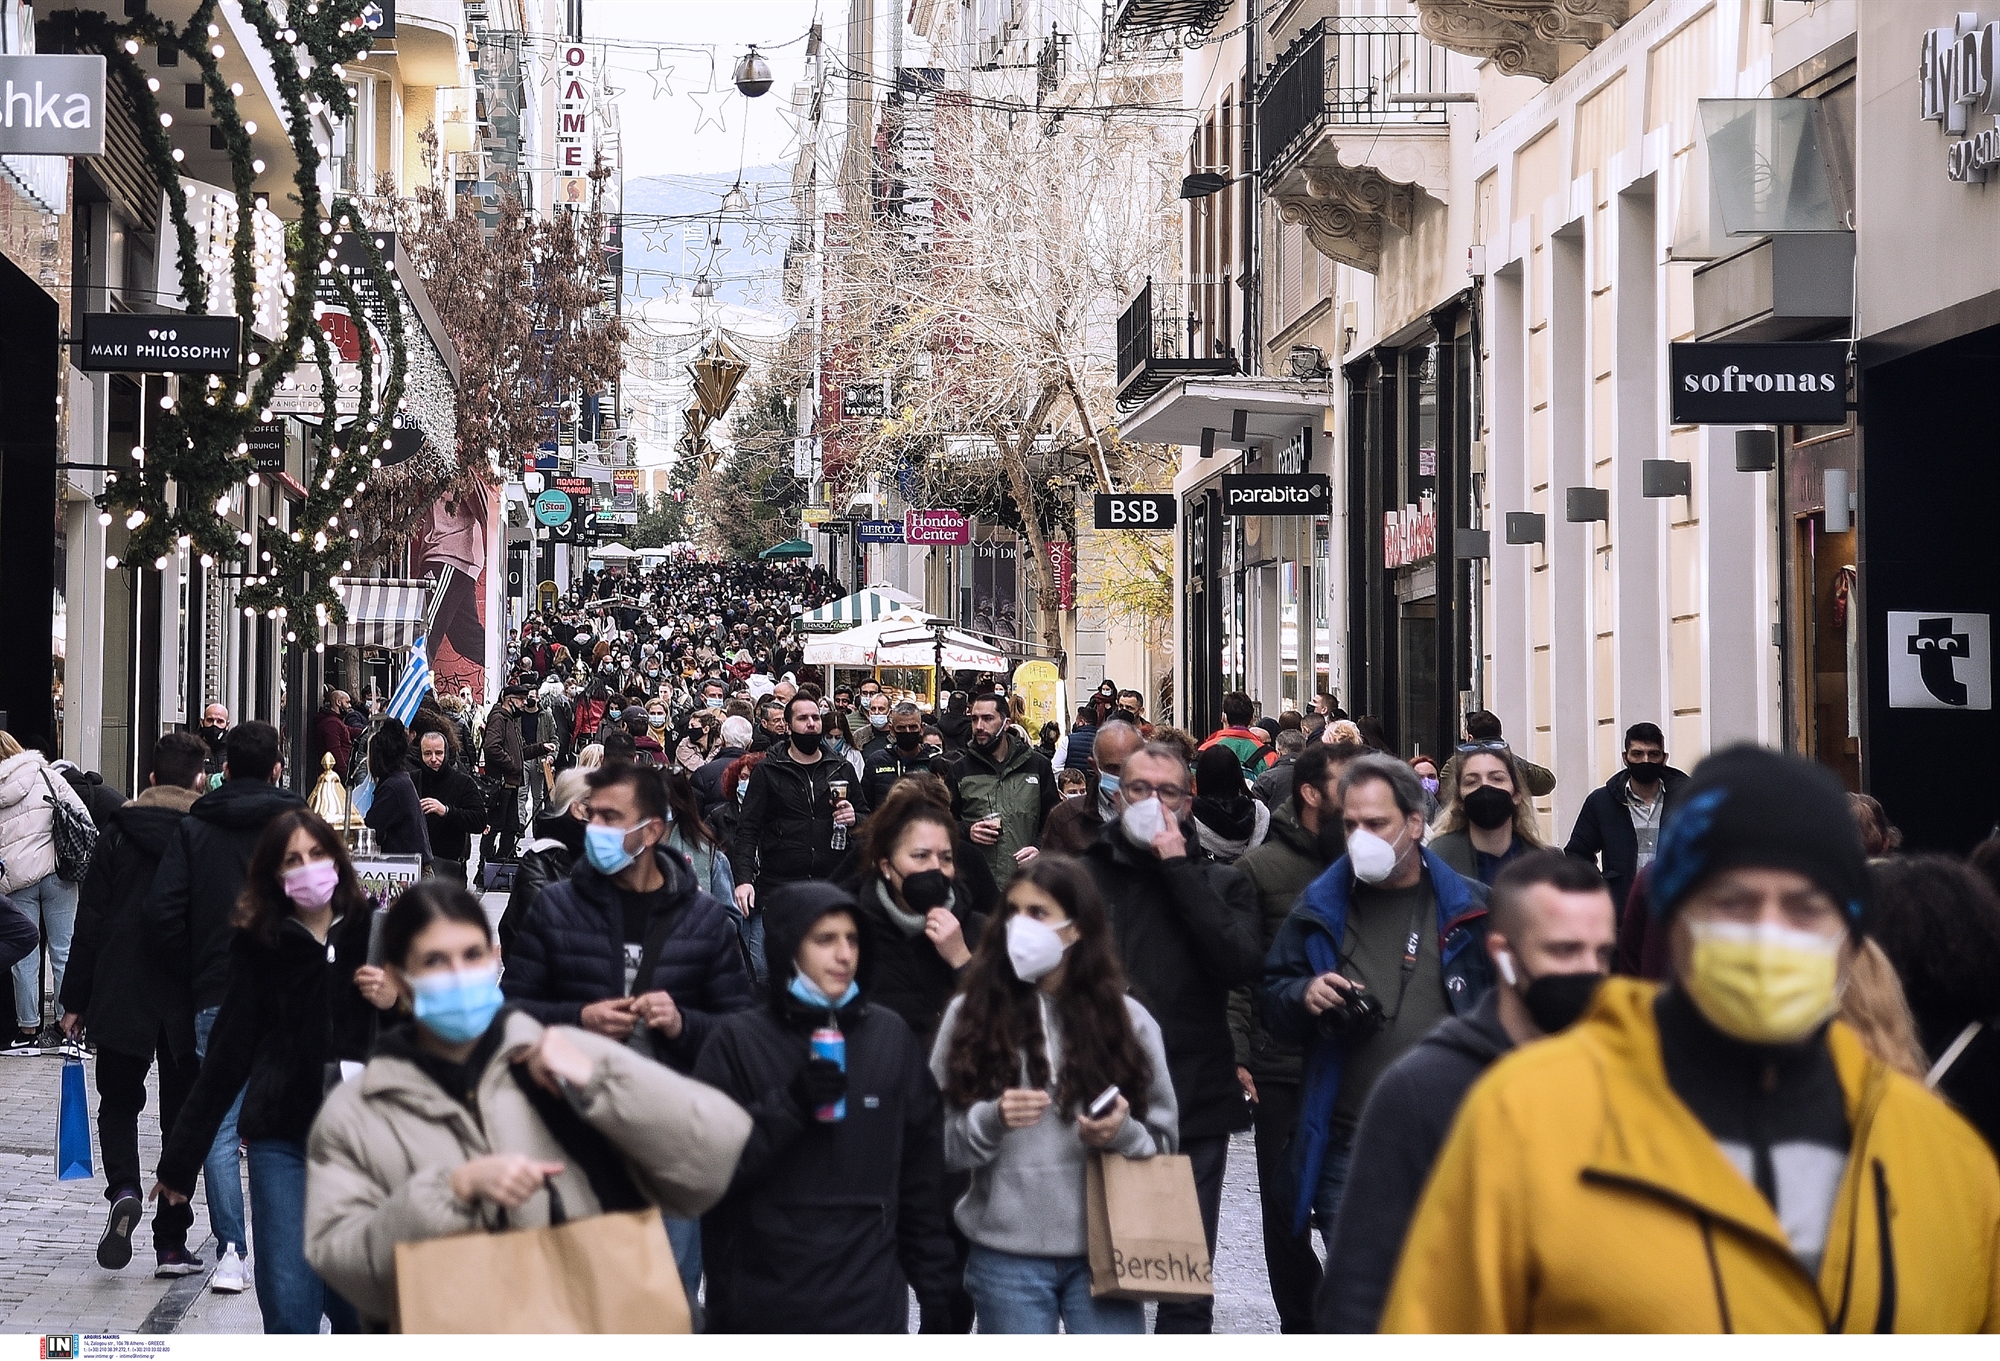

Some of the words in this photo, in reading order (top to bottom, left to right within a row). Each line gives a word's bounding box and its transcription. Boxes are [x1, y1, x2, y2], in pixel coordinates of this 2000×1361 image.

[91, 345, 127, 357] MAKI
[136, 345, 231, 359] PHILOSOPHY
[1684, 365, 1836, 393] sofronas
[1229, 485, 1310, 505] parabita
[1110, 500, 1159, 523] BSB
[911, 513, 965, 528] Hondos
[911, 527, 959, 541] Center
